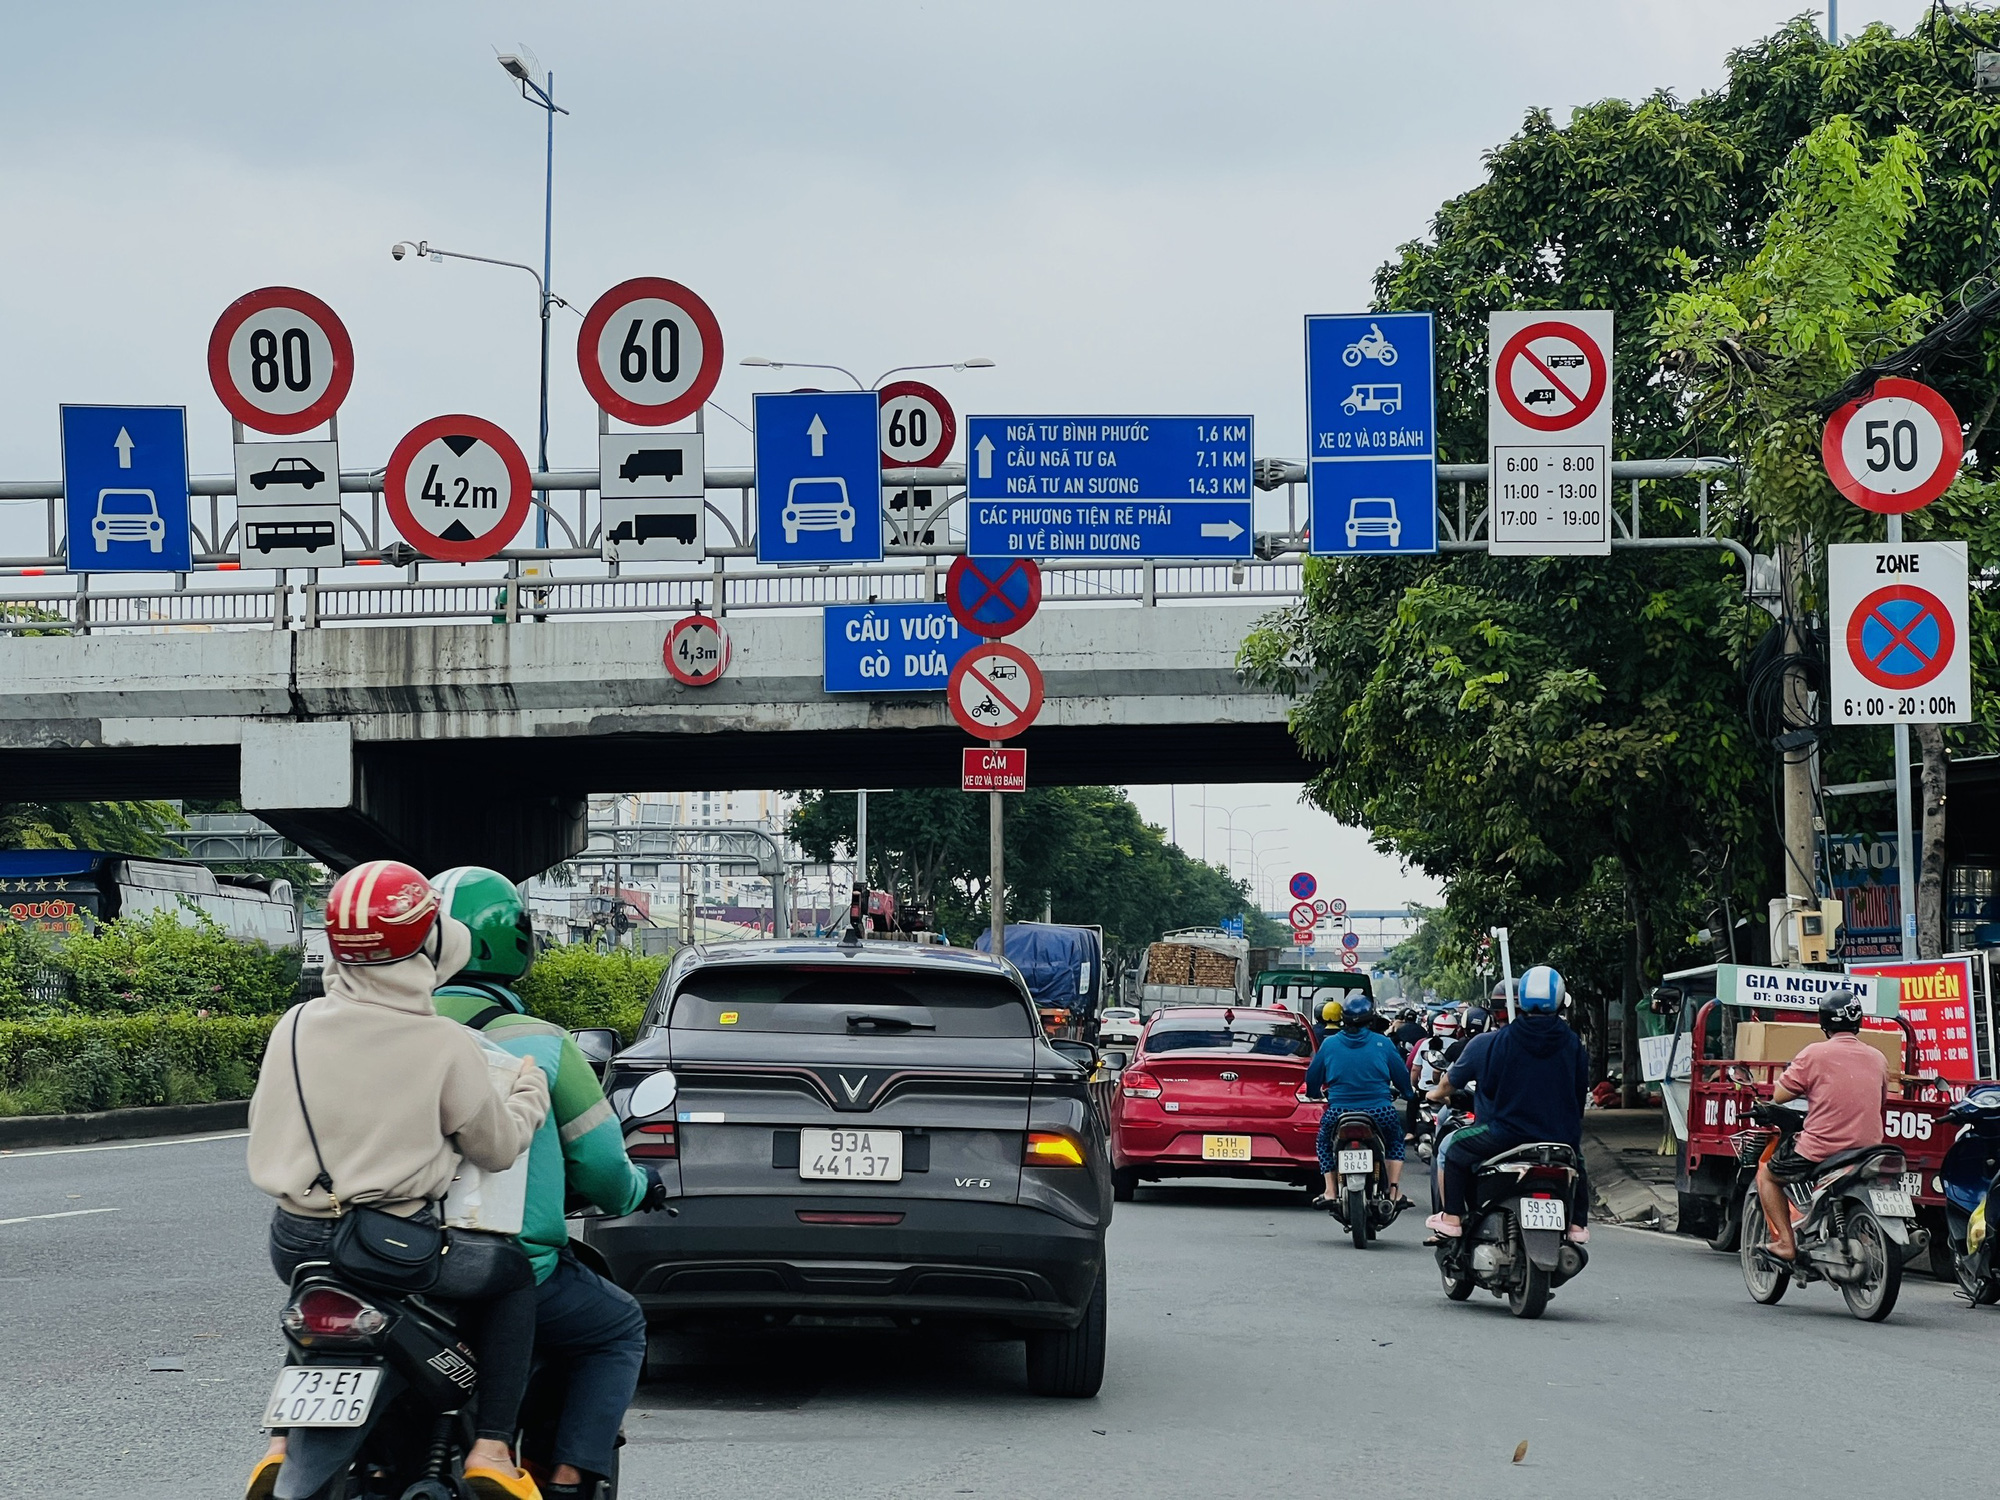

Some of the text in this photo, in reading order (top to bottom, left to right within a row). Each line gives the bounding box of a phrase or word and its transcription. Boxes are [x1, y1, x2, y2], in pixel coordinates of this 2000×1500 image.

[250, 328, 311, 393] 80
[619, 318, 680, 383] 60
[888, 408, 927, 448] 60
[1007, 421, 1246, 443] NGÃ TƯ BÌNH PHƯỚC 1,6 KM
[1319, 427, 1424, 448] XE 02 VÀ 03 BÁNH
[1007, 445, 1246, 468] CẦU NGÃ TƯ GA 7,1 KM
[1866, 420, 1918, 472] 50
[1507, 457, 1538, 472] 6:00
[1562, 457, 1594, 472] 8:00
[420, 464, 498, 509] 4.2m
[1007, 476, 1246, 495] NGÃ TƯ AN SƯƠNG 14,3 KM
[1503, 484, 1539, 499] 11:00
[1558, 484, 1597, 499] 13:00
[980, 504, 1171, 527] CÁC PHƯƠNG TIỆN RẼ PHẢI
[1500, 511, 1537, 525] 17:00
[1562, 511, 1600, 525] 19:00
[1008, 528, 1141, 551] ĐI VỀ BÌNH DƯƠNG
[1876, 555, 1919, 573] ZONE
[845, 610, 959, 645] CẦU VƯỢT
[859, 649, 948, 677] GÒ DƯA
[982, 750, 1007, 770] CẤM
[965, 773, 1023, 786] XE 02 VÀ 03 BÁNH
[1746, 974, 1779, 990] GIA
[1901, 966, 1960, 1000] TUYỂN
[1753, 992, 1771, 1001] ĐT:
[1775, 993, 1805, 1005] 0363
[1910, 1008, 1928, 1021] INOX
[1885, 1110, 1932, 1140] 505
[831, 1132, 872, 1153] 93A
[1209, 1148, 1245, 1158] 318.59
[1217, 1138, 1237, 1148] 51H
[812, 1155, 890, 1177] 441.37
[1343, 1152, 1368, 1161] 53-XA
[1344, 1162, 1368, 1171] 9645
[953, 1177, 991, 1189] VF6
[1527, 1201, 1558, 1214] 59-S3
[1524, 1214, 1562, 1228] 121.70
[291, 1372, 362, 1395] 73-E1
[272, 1398, 364, 1421] 407.06
